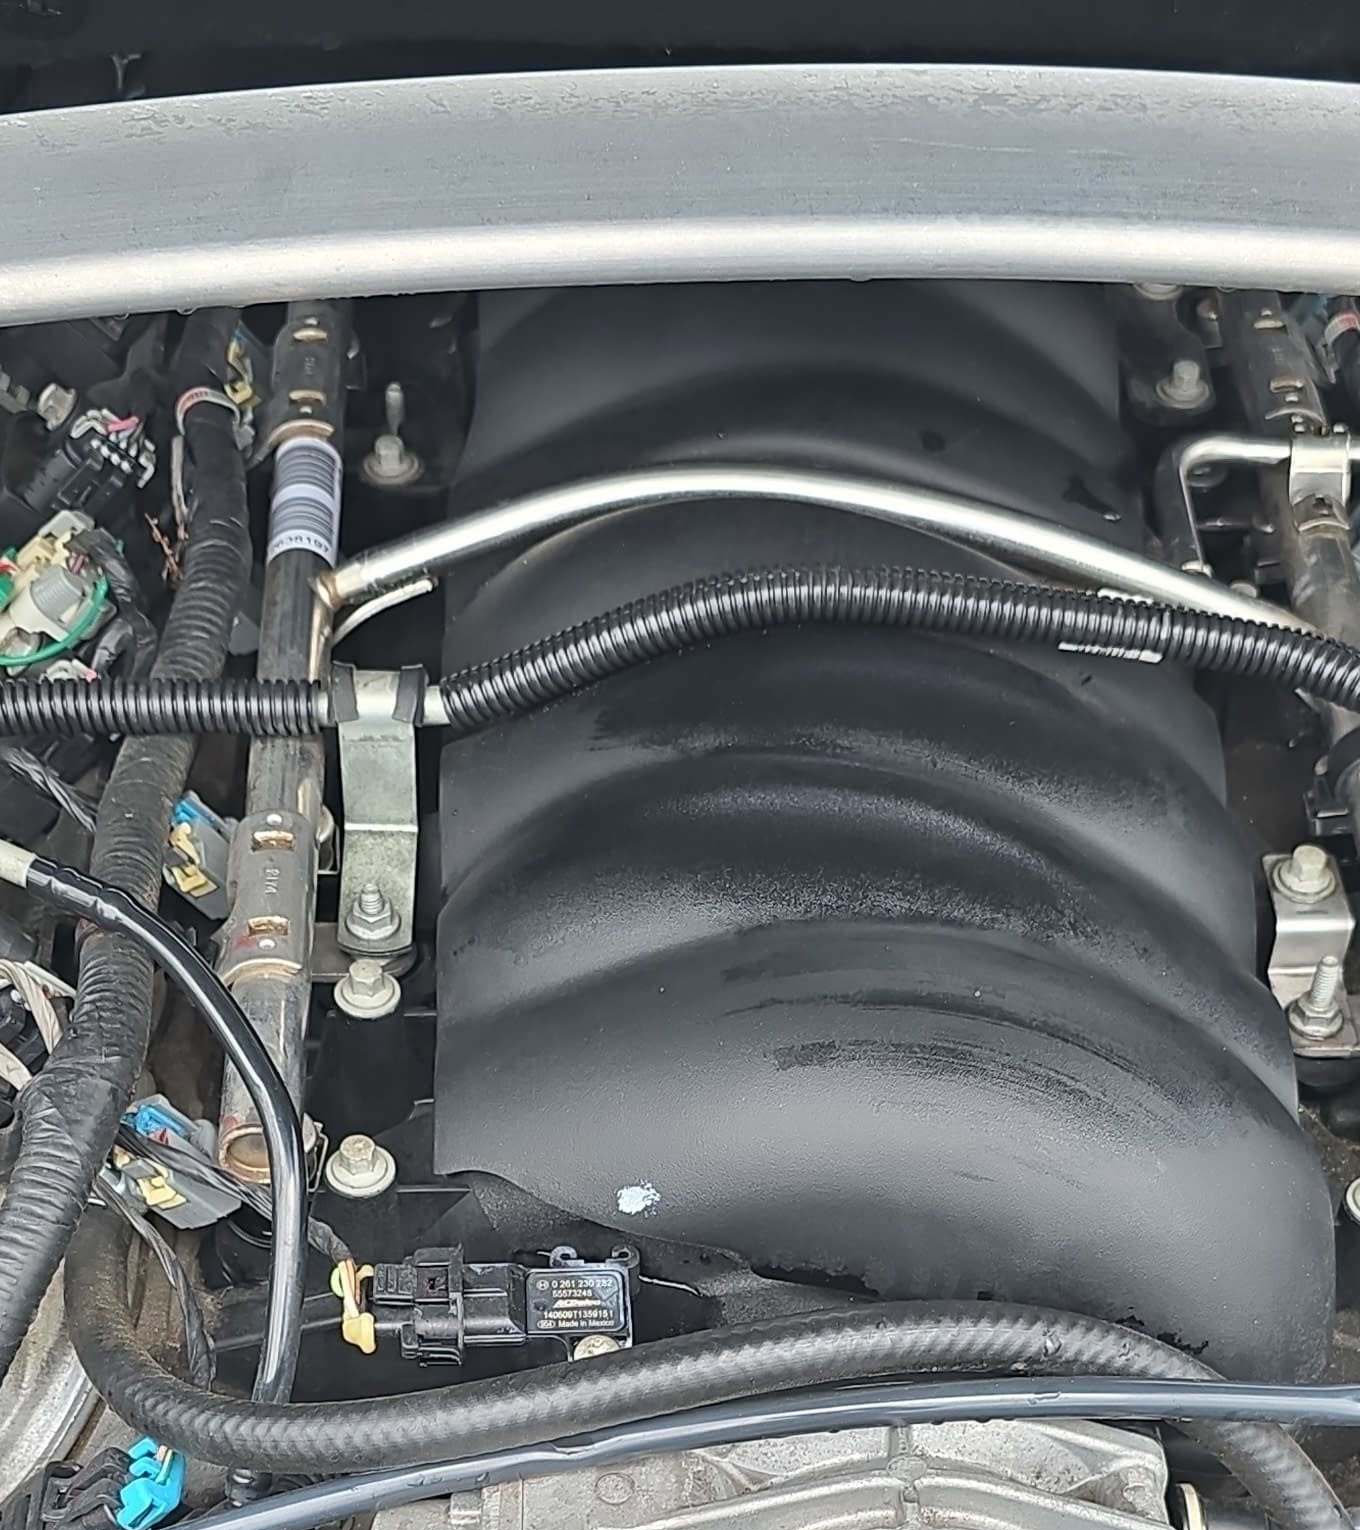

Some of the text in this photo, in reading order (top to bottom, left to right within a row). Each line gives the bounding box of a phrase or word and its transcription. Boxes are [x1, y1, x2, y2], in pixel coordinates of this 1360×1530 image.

[558, 1320, 579, 1328] Made
[580, 1320, 587, 1328] in
[588, 1319, 615, 1327] Mexico
